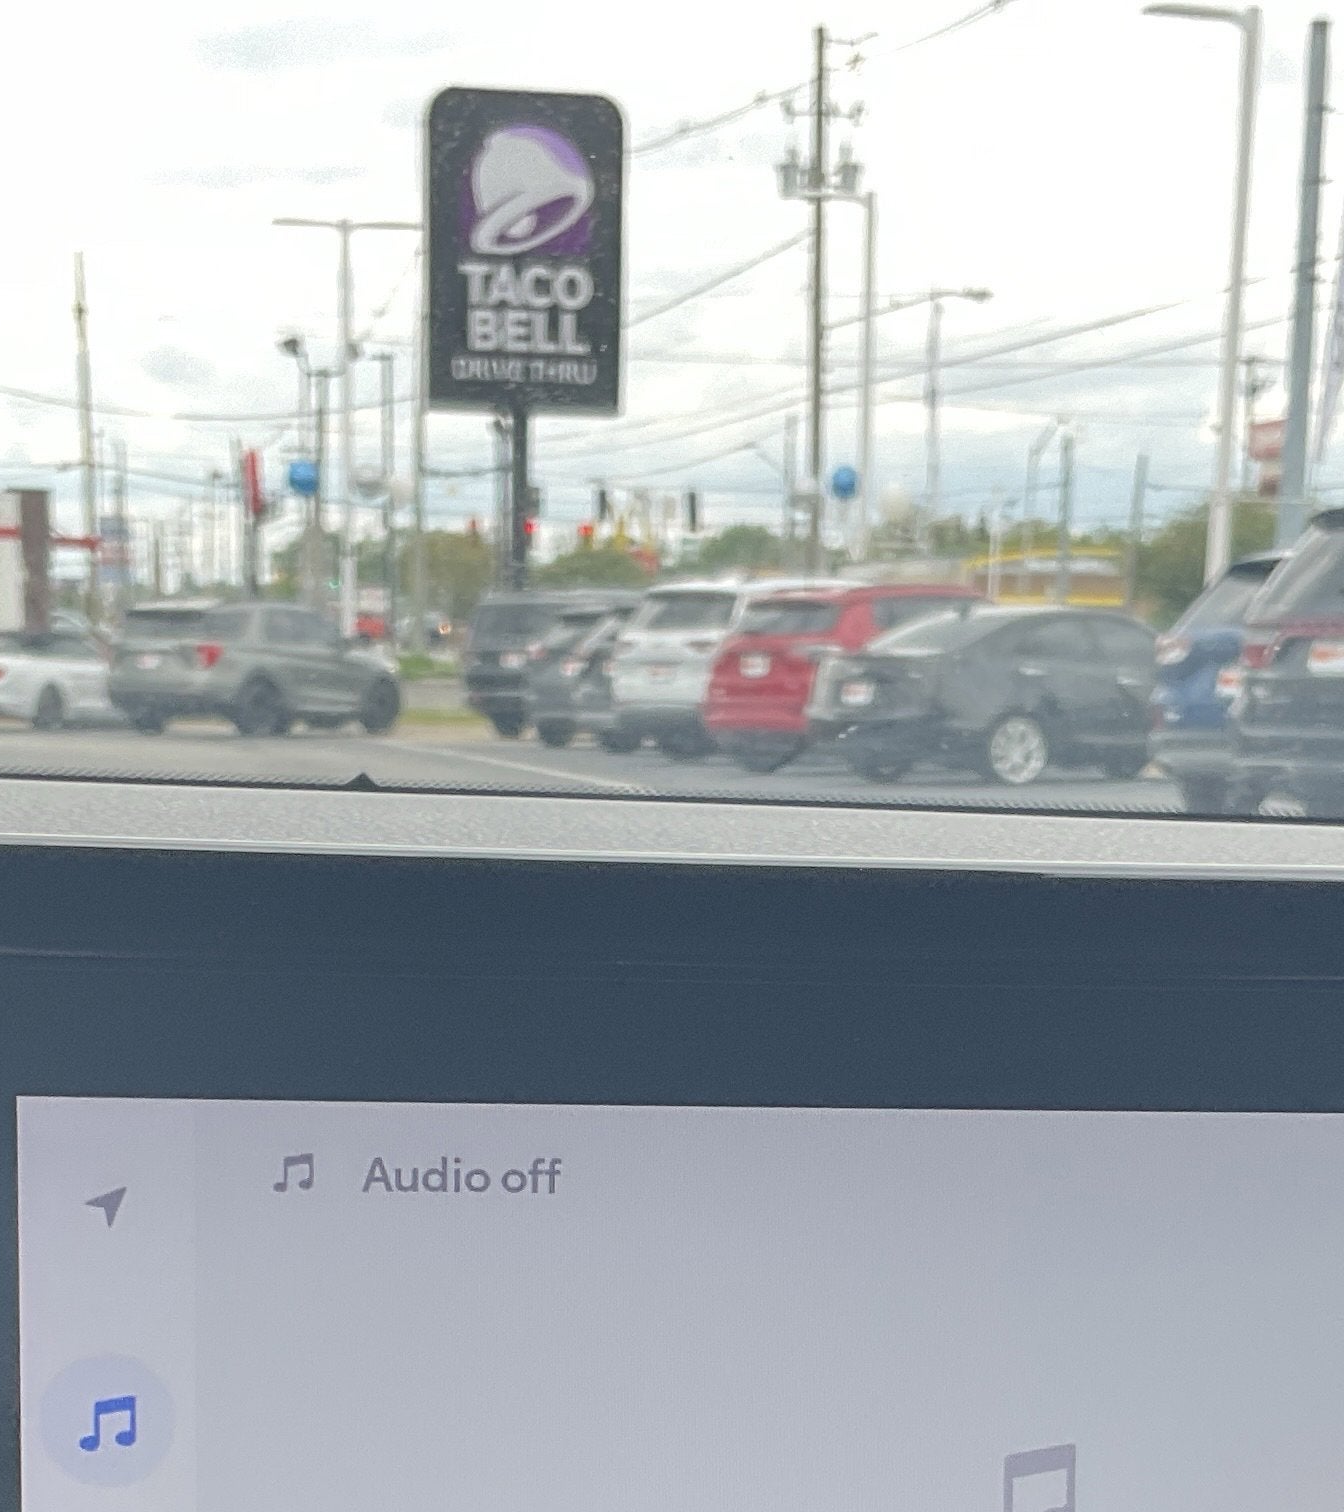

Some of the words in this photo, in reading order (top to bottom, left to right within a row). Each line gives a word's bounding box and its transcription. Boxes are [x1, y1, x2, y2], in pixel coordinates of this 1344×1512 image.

[457, 260, 595, 311] TACO
[467, 309, 591, 355] BELL
[362, 1157, 490, 1194] Audio
[501, 1157, 563, 1194] off
